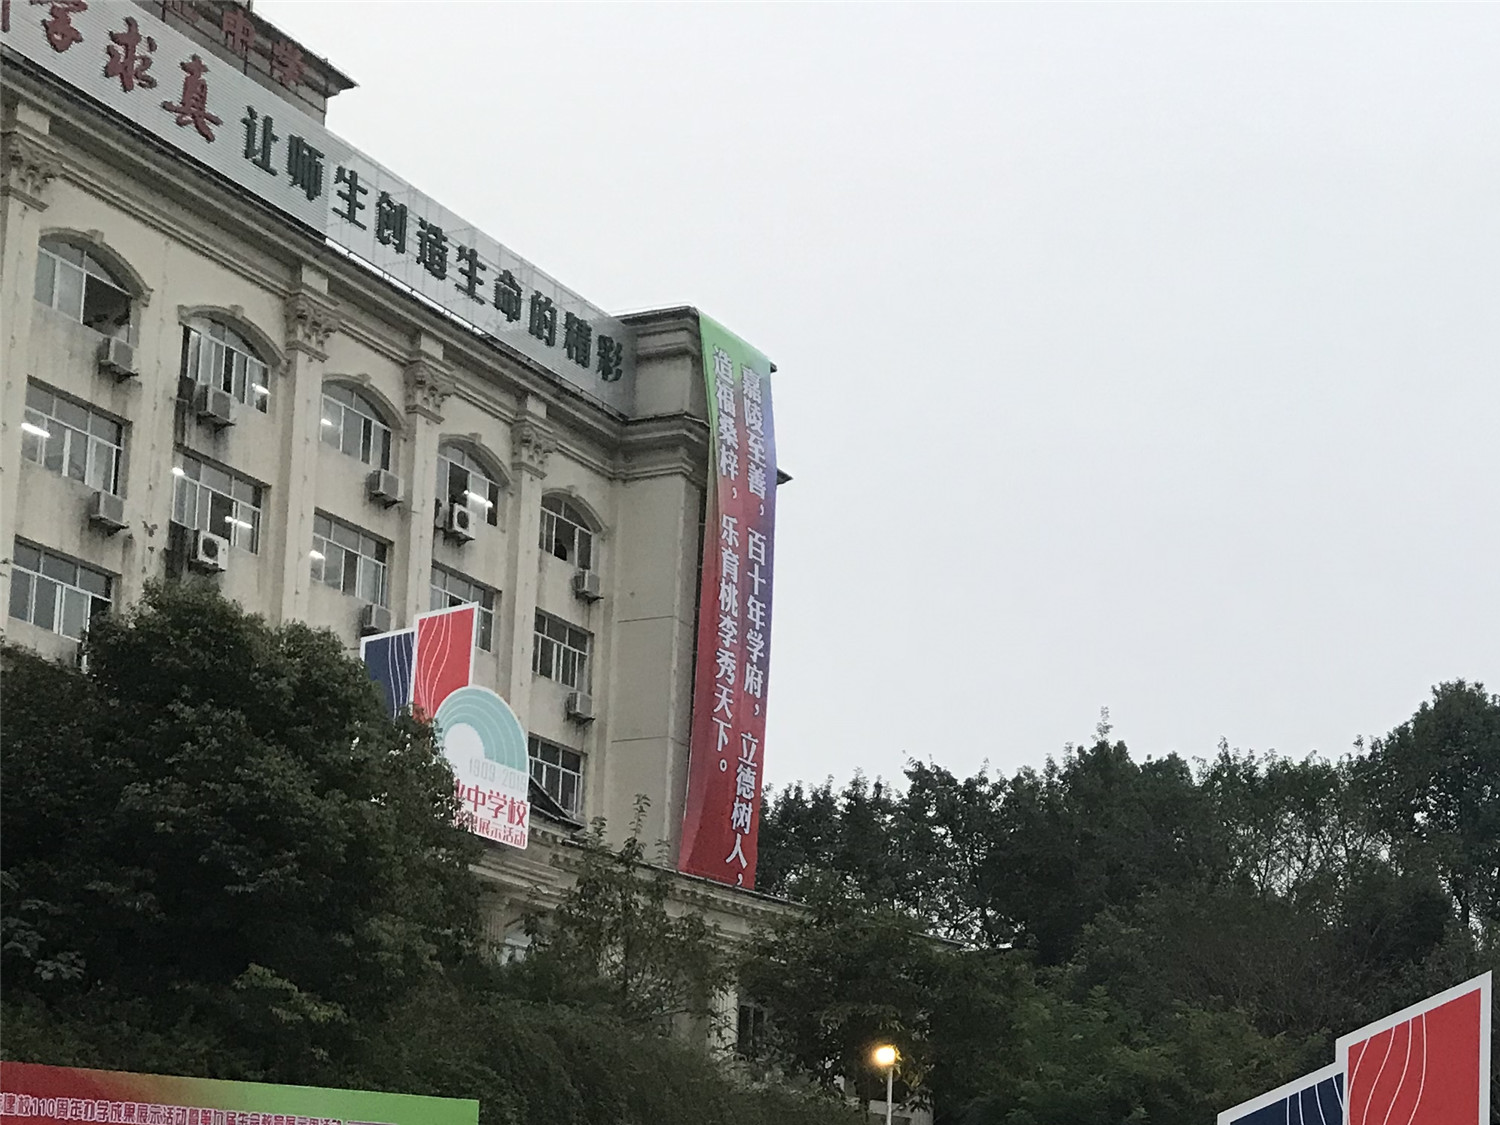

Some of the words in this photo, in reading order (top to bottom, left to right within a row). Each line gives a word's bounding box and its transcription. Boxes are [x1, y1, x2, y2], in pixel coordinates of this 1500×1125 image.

[241, 105, 623, 382] 让师生创造生命的精彩
